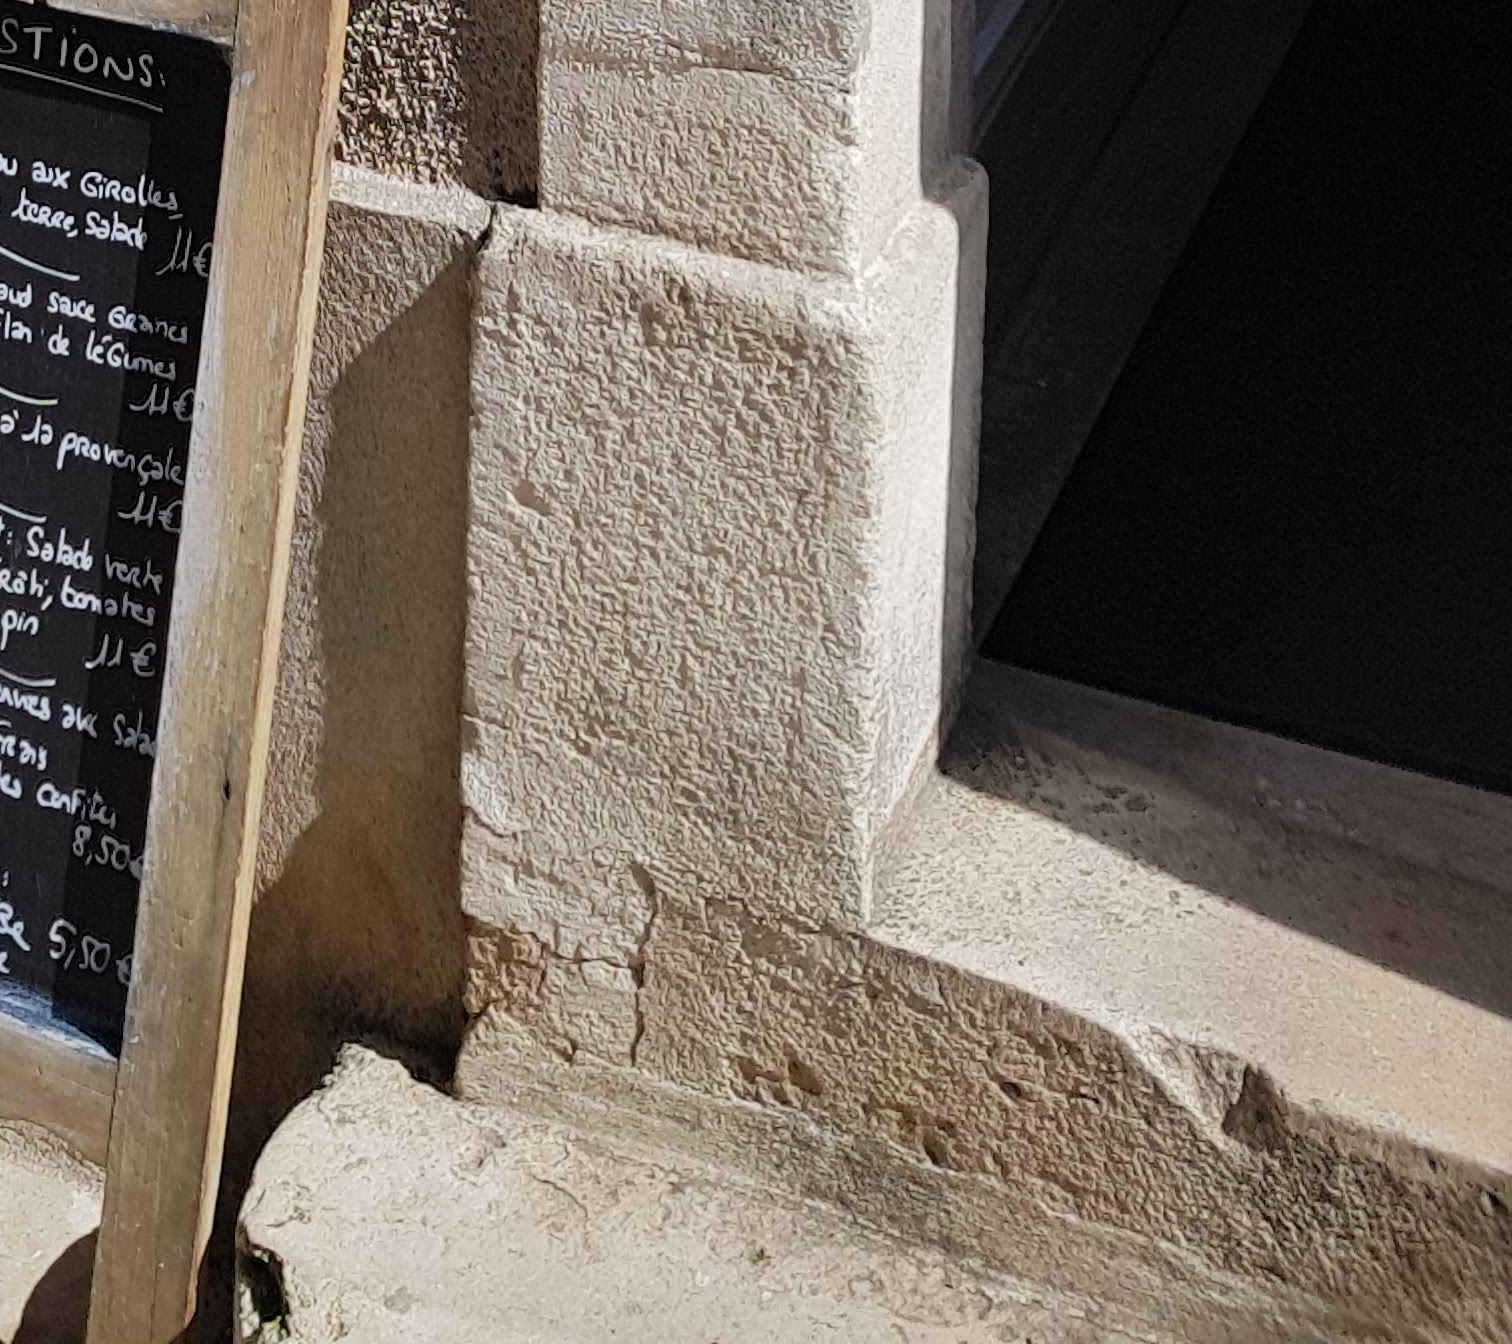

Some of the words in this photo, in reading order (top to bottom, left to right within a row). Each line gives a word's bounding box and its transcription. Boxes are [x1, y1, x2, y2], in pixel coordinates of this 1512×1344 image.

[30, 160, 70, 190] aux
[48, 291, 95, 323] sauce
[48, 324, 70, 356] de
[0, 409, 20, 434] à
[21, 413, 54, 446] la
[56, 430, 185, 487] provençale
[104, 553, 163, 595] verte
[59, 575, 156, 627] tomates
[0, 608, 39, 651] pin
[61, 701, 98, 739] avec
